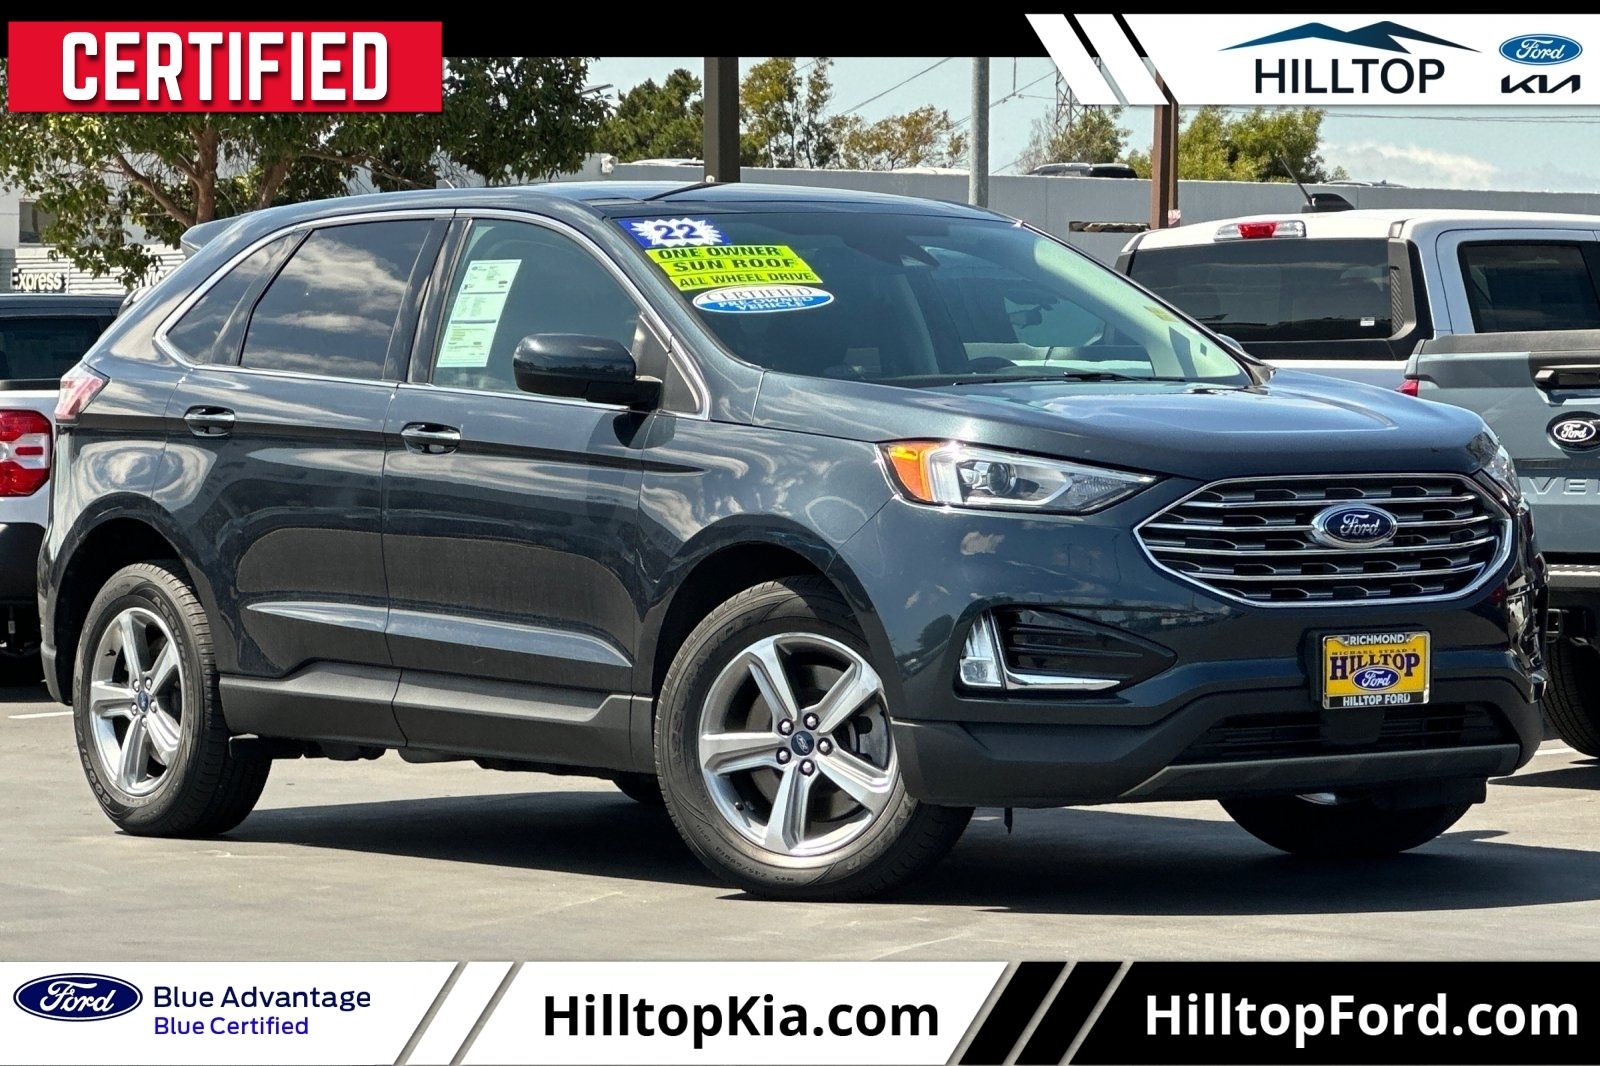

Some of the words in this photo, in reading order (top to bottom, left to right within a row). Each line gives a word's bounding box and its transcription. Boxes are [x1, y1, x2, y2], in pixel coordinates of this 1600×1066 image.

[653, 223, 704, 240] 22
[657, 248, 700, 260] ONE
[707, 246, 779, 257] OWNER
[673, 260, 723, 272] SUN
[732, 258, 796, 269] ROOF
[10, 268, 63, 292] Express
[679, 276, 708, 288] ALL
[711, 273, 765, 284] WHEEL
[769, 271, 813, 282] DRIVE
[706, 287, 813, 301] CERTIFIED
[738, 301, 806, 311] VEHICLE
[1339, 513, 1381, 537] Ford
[1349, 634, 1405, 645] RICHMOND
[1329, 652, 1420, 681] HILLTOP
[1342, 694, 1382, 706] HILLTOP
[1385, 693, 1411, 703] FORD
